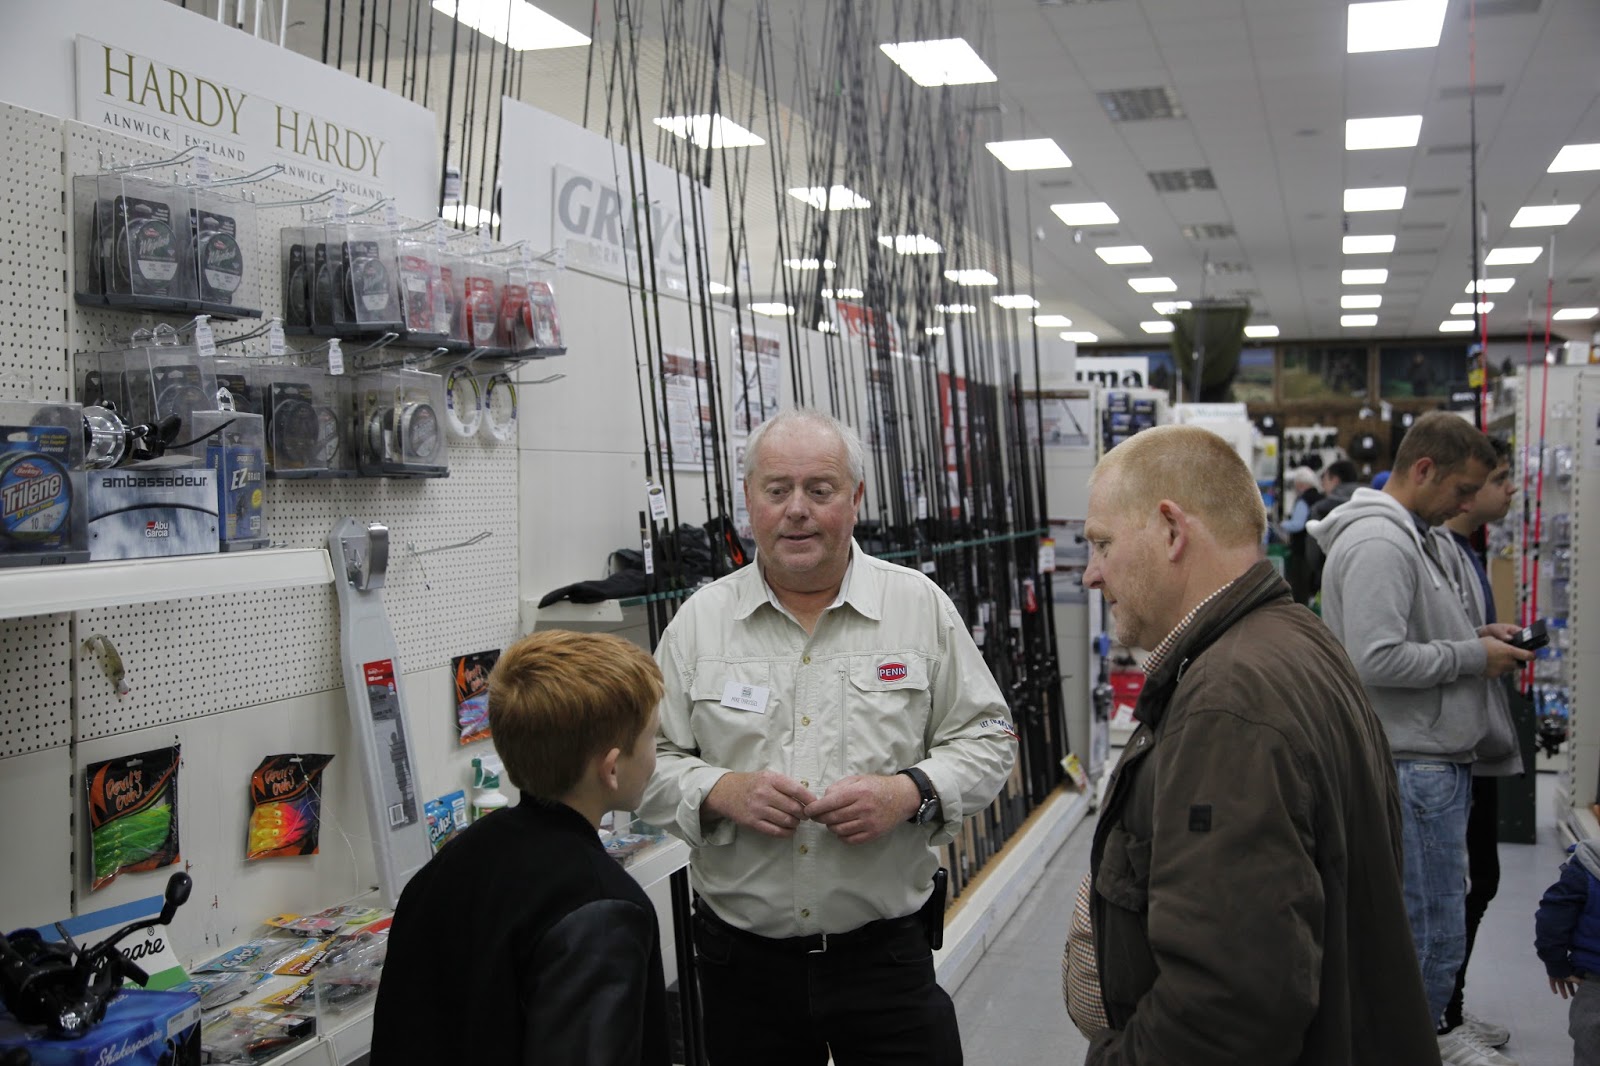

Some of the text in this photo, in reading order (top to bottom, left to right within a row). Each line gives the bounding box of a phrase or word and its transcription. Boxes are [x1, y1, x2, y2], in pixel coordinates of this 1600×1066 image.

[102, 45, 247, 135] HARDY
[103, 111, 171, 142] ALNWICK
[275, 104, 385, 178] HARDY
[558, 175, 694, 266] GREYS
[1076, 369, 1144, 389] ma
[102, 475, 207, 488] ambassadeur
[231, 467, 248, 490] EZ
[3, 474, 61, 513] Trilene
[31, 518, 39, 530] 10
[145, 529, 169, 538] Garcia
[153, 522, 169, 530] Abu
[879, 667, 905, 677] PENN
[430, 810, 452, 842] Gulp!
